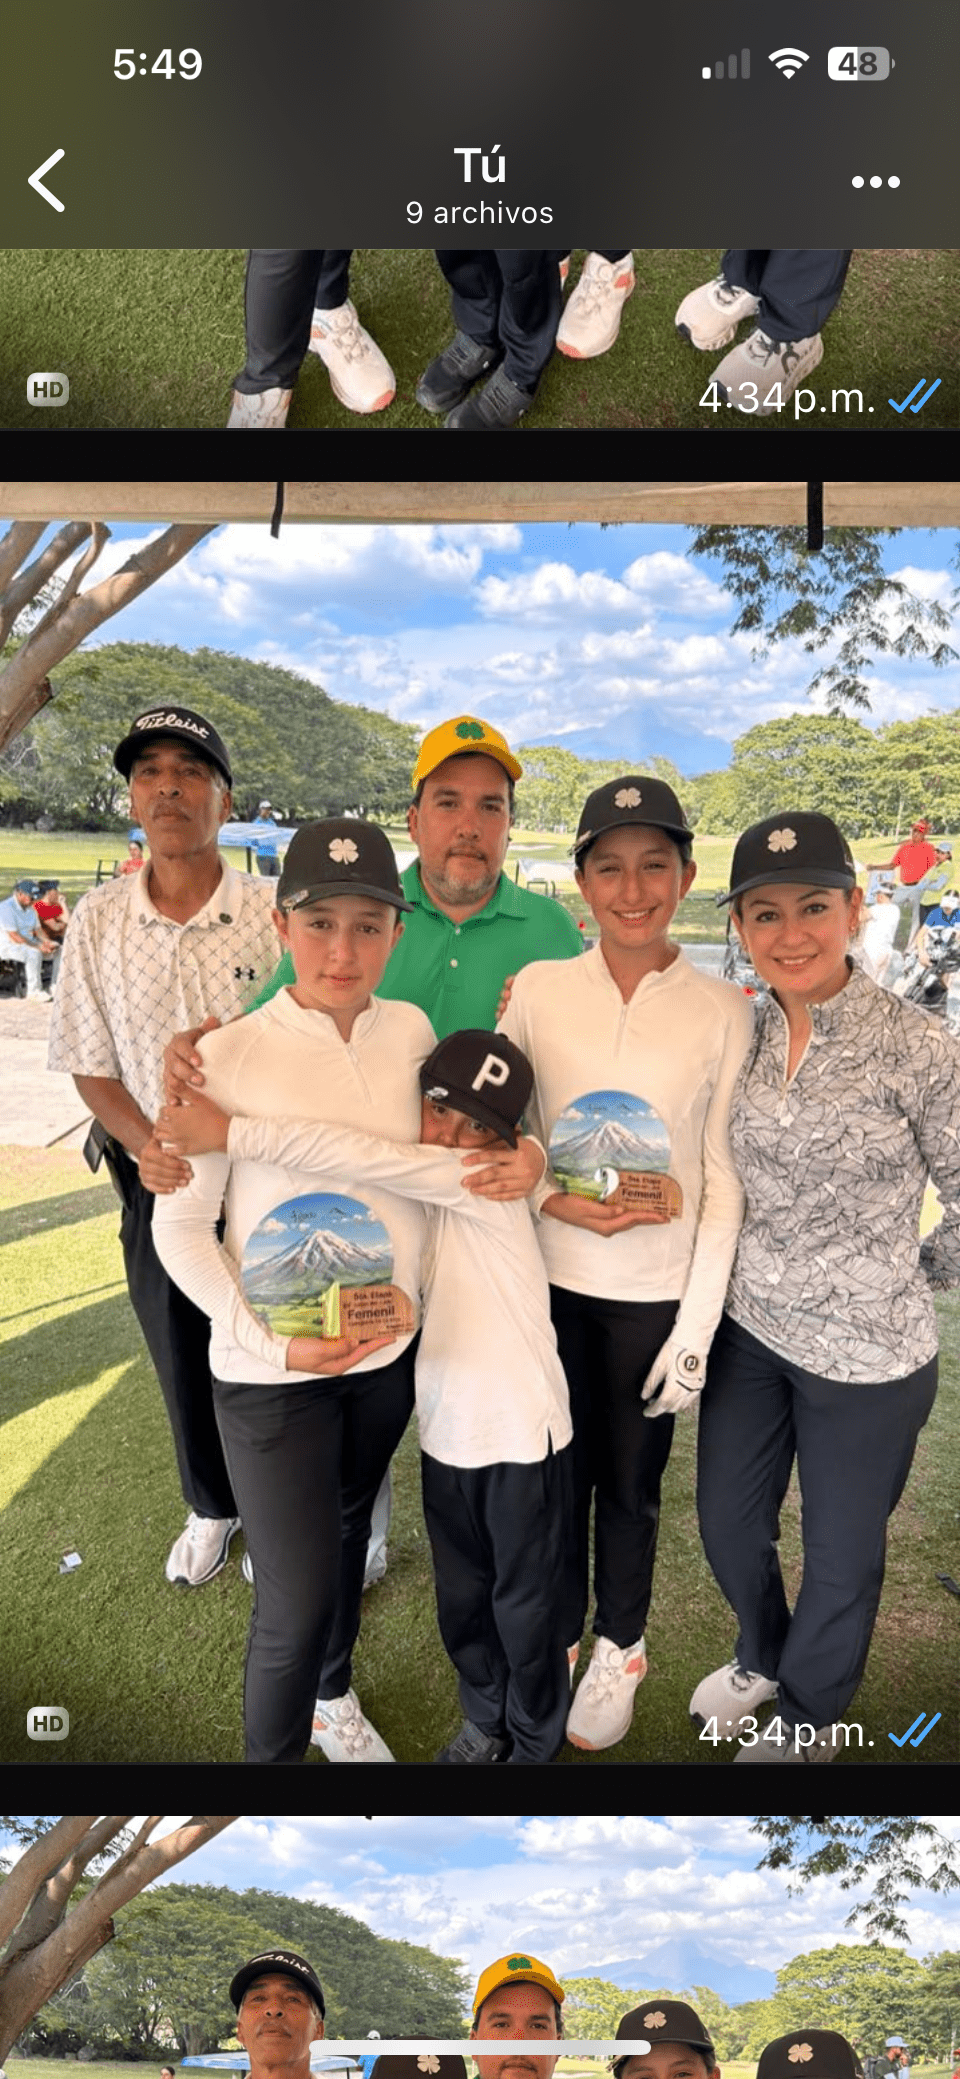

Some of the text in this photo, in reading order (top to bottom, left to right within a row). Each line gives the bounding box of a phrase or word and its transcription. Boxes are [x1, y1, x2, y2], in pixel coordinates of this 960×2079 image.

[135, 711, 210, 739] Titleist
[472, 1053, 510, 1091] P
[347, 1305, 395, 1320] Femenil
